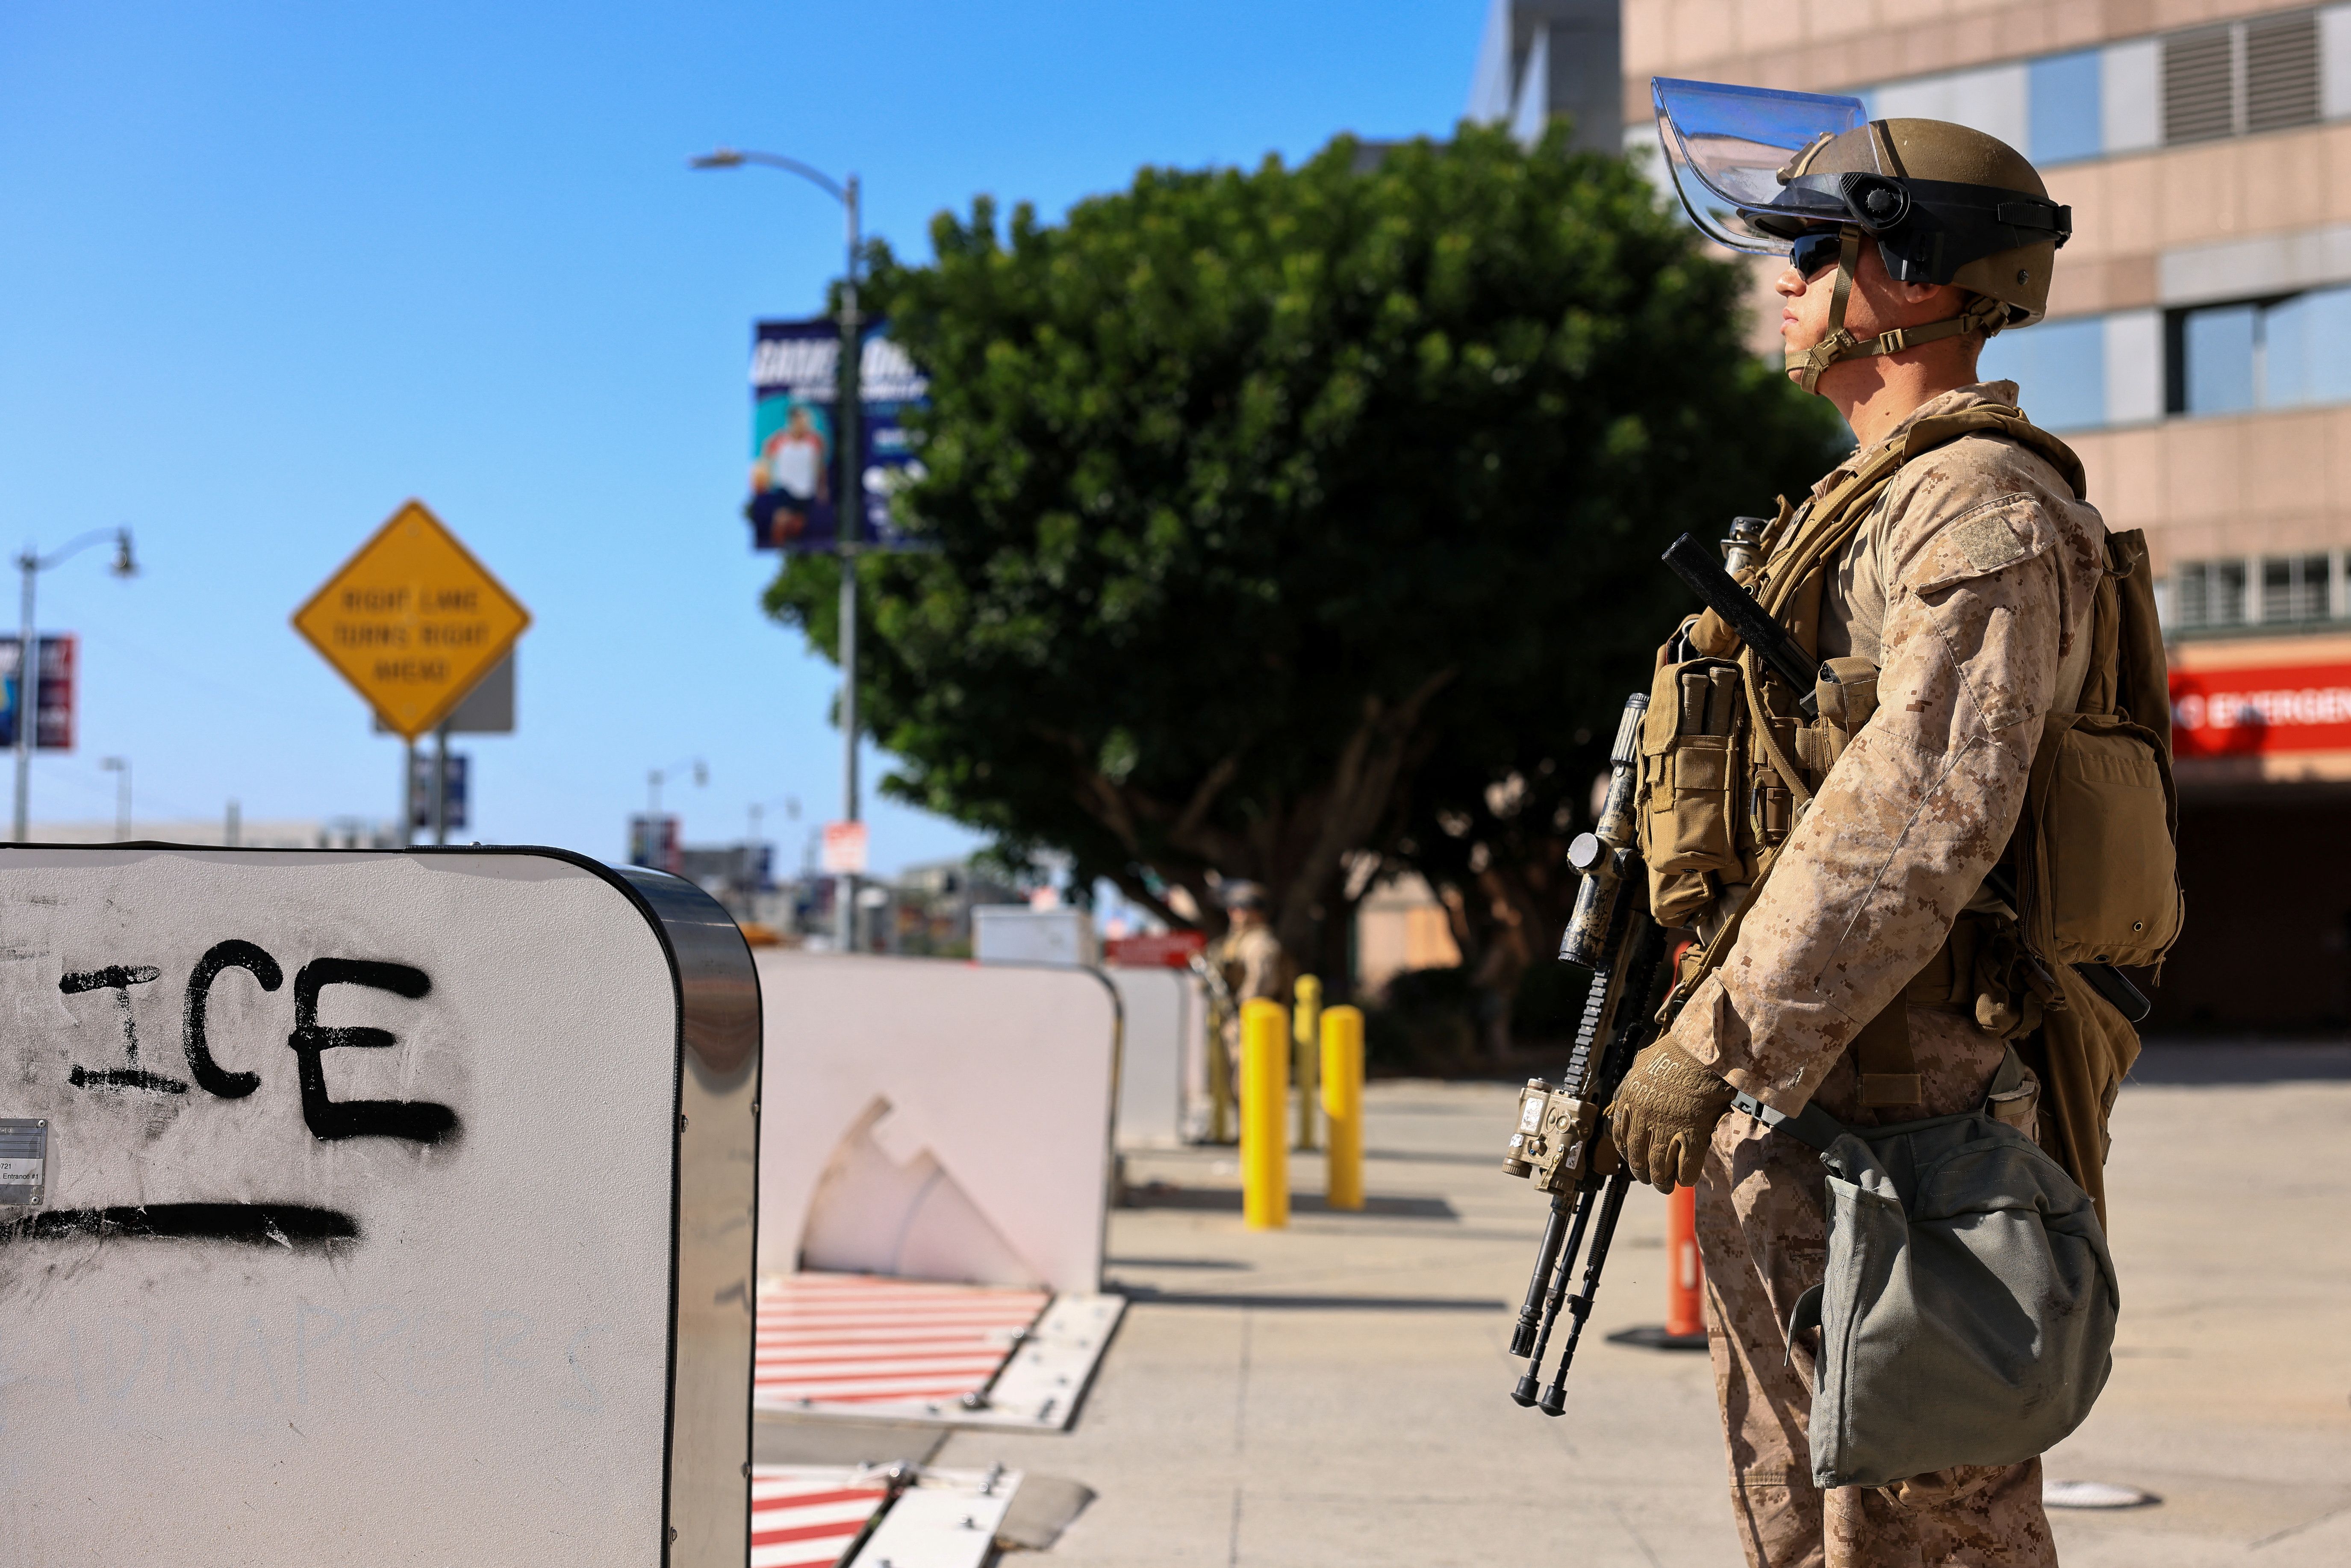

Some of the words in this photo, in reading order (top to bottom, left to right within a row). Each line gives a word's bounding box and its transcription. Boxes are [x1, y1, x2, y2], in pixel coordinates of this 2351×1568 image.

[342, 586, 410, 612] RIGHT
[420, 586, 478, 612] LANE
[334, 621, 410, 648] TURNS
[418, 621, 490, 648] RIGHT
[373, 657, 450, 684] AHEAD
[59, 940, 463, 1143] ICE
